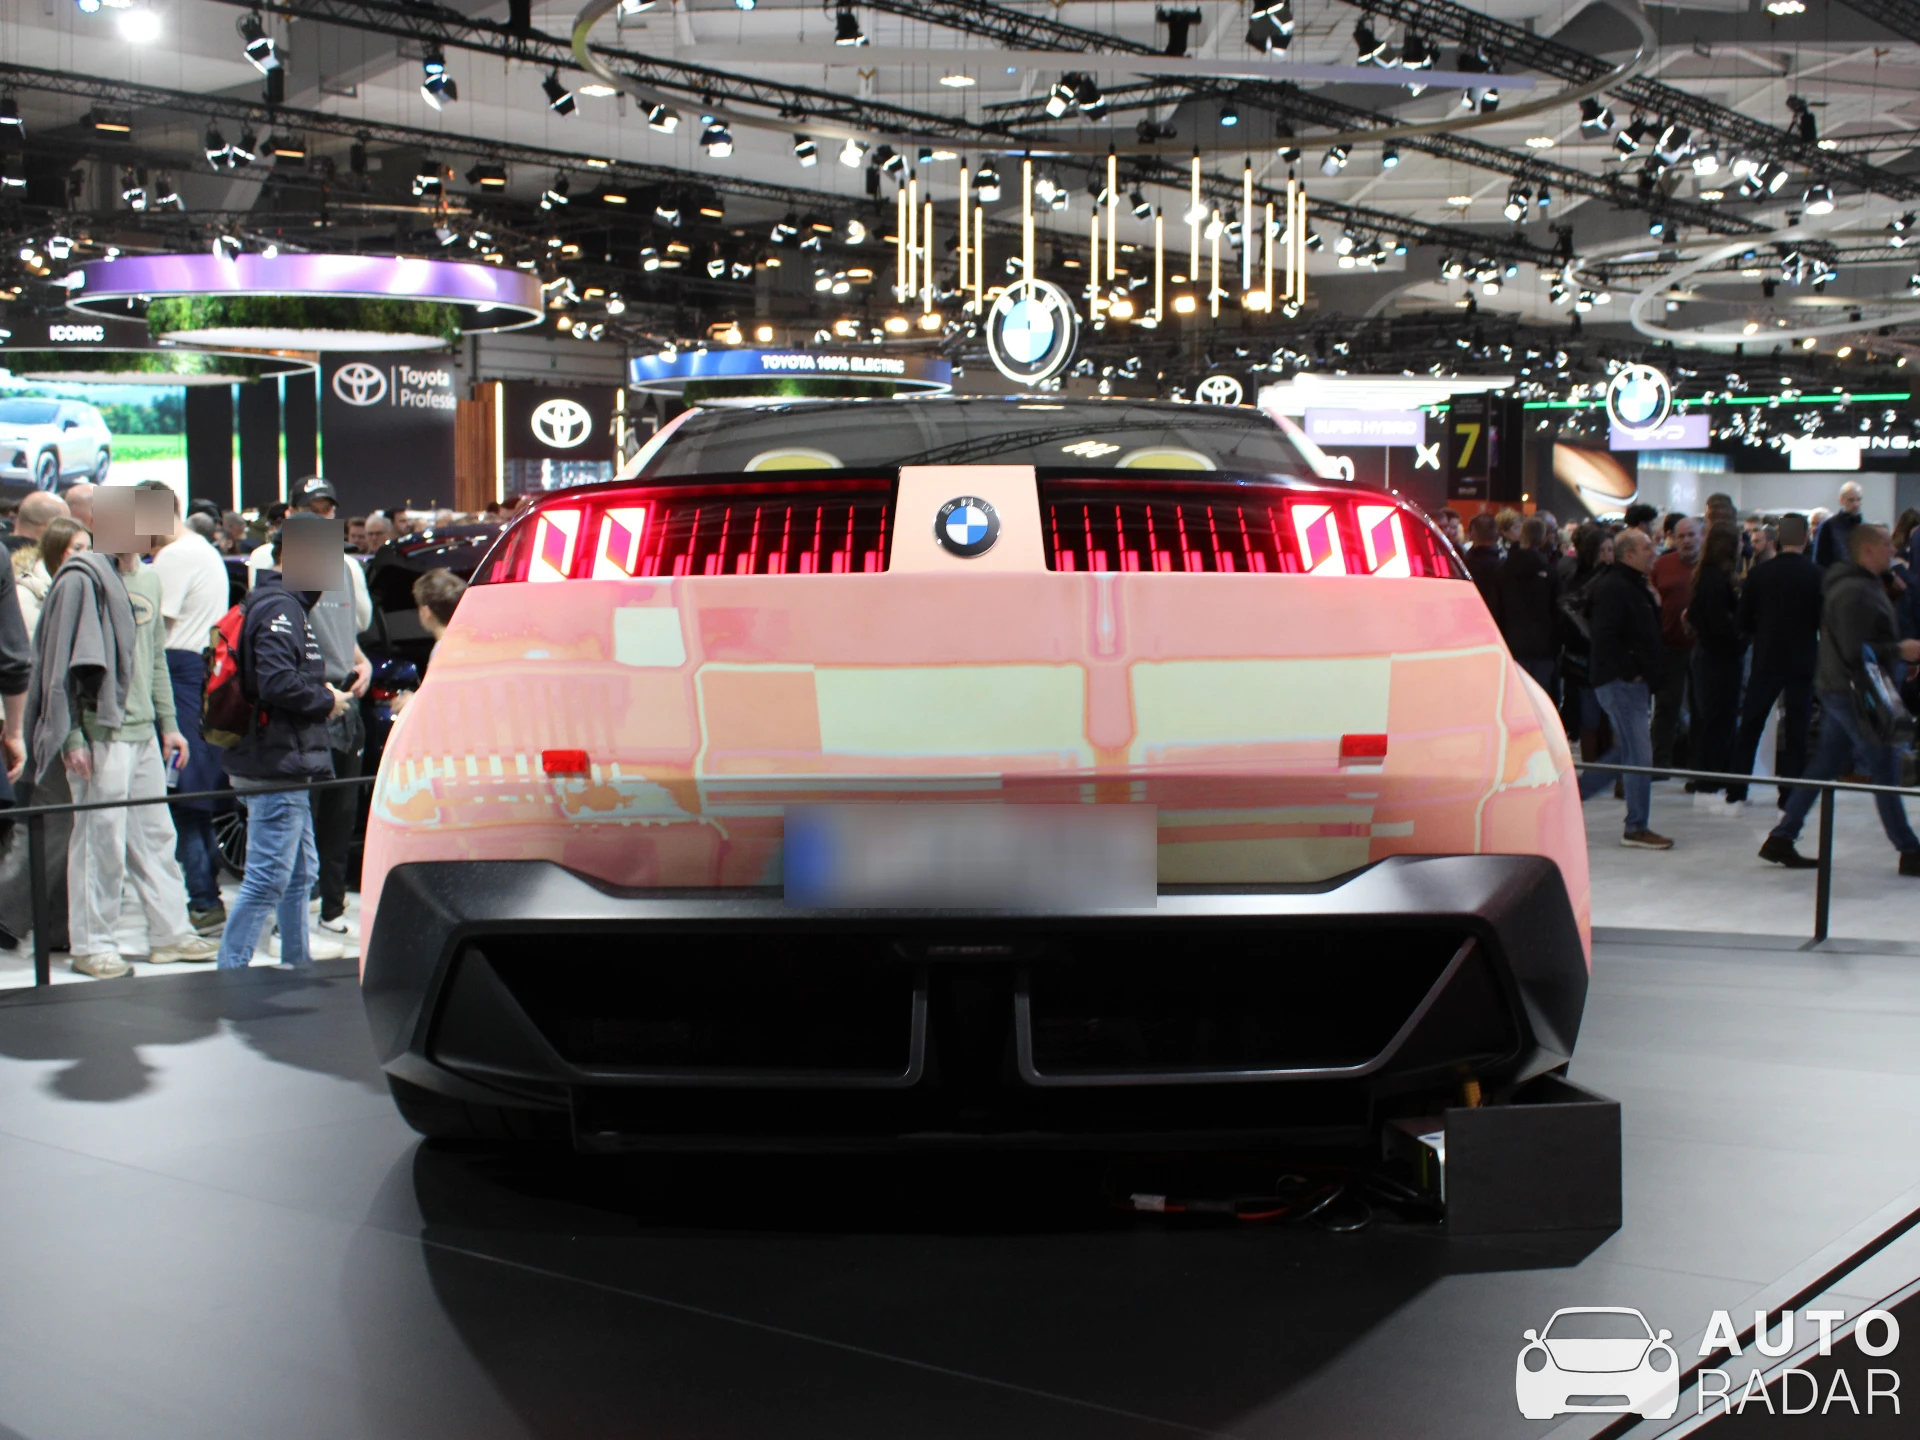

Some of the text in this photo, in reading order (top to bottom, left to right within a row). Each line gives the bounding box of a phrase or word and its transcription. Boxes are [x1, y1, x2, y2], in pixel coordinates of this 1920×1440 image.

[49, 324, 104, 341] ICONIC
[761, 355, 905, 374] TOYOTA 100% ELECTRIC
[399, 365, 450, 389] Toyota
[1313, 420, 1417, 434] SUPER HYBRID
[1455, 423, 1480, 468] 7
[941, 497, 994, 515] BMW
